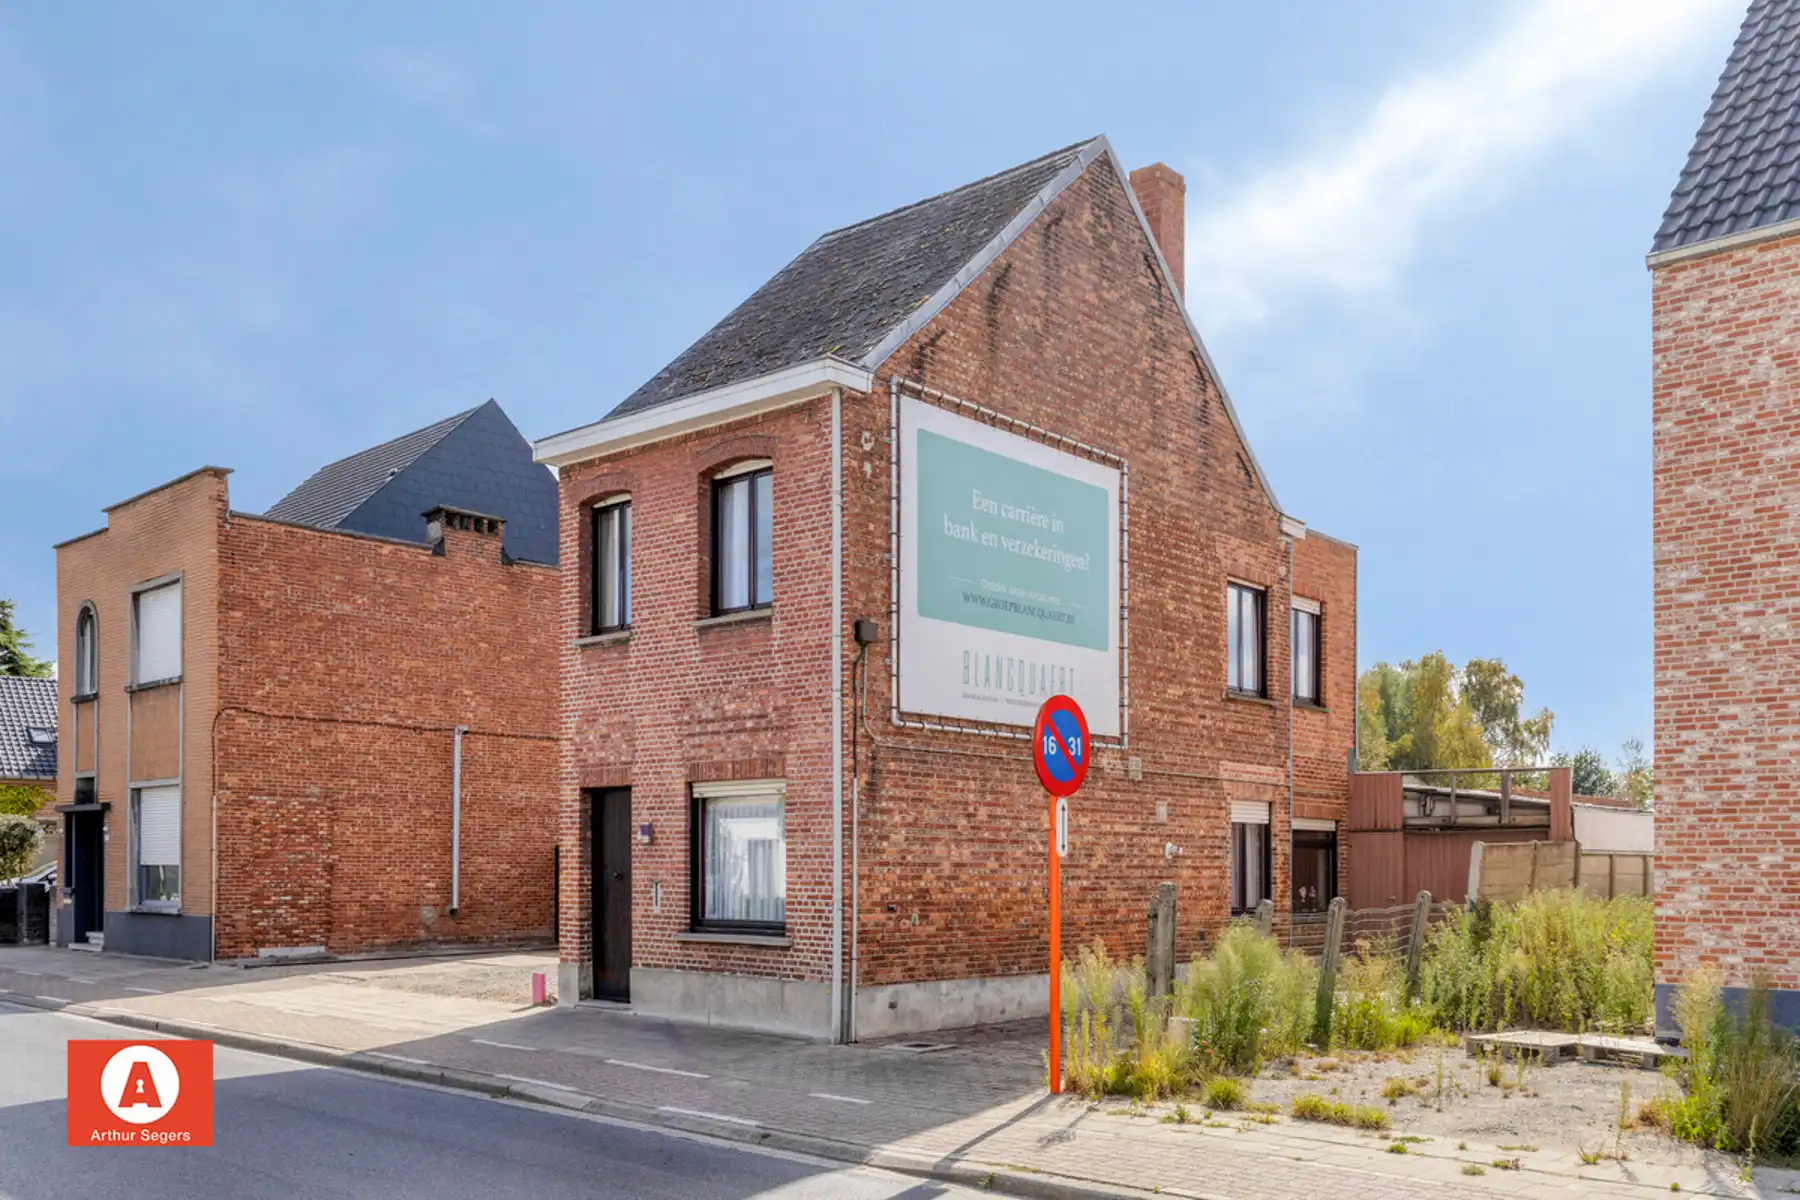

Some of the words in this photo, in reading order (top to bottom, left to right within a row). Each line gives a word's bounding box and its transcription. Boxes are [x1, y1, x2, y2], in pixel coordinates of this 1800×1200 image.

[972, 488, 998, 515] Een
[1001, 505, 1049, 529] carrière
[1052, 510, 1064, 534] in
[944, 513, 978, 543] bank
[981, 531, 998, 549] en
[1001, 536, 1090, 572] verzekeringen?
[1043, 735, 1057, 755] 16
[1068, 736, 1081, 756] 31
